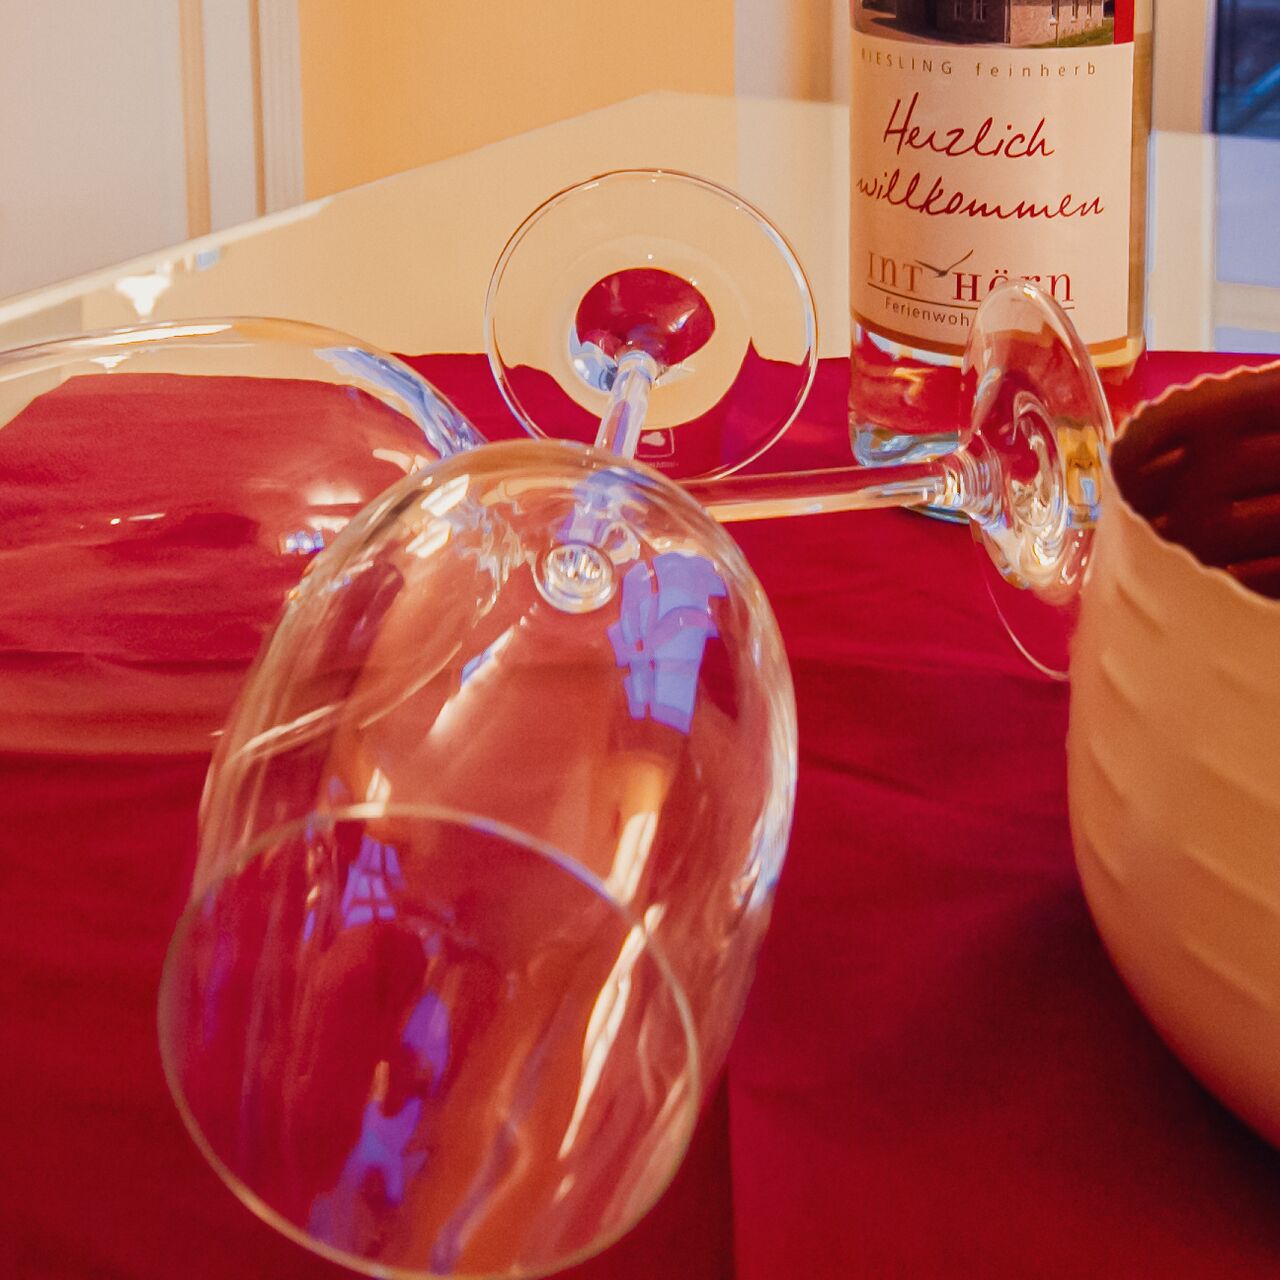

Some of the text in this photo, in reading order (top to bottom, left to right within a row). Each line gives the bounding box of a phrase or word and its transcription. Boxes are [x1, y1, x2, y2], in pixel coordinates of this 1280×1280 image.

[975, 61, 1096, 77] feinherb
[883, 91, 1055, 158] Herzlich
[857, 168, 1105, 219] willkommen
[885, 296, 970, 327] Ferienwoh
